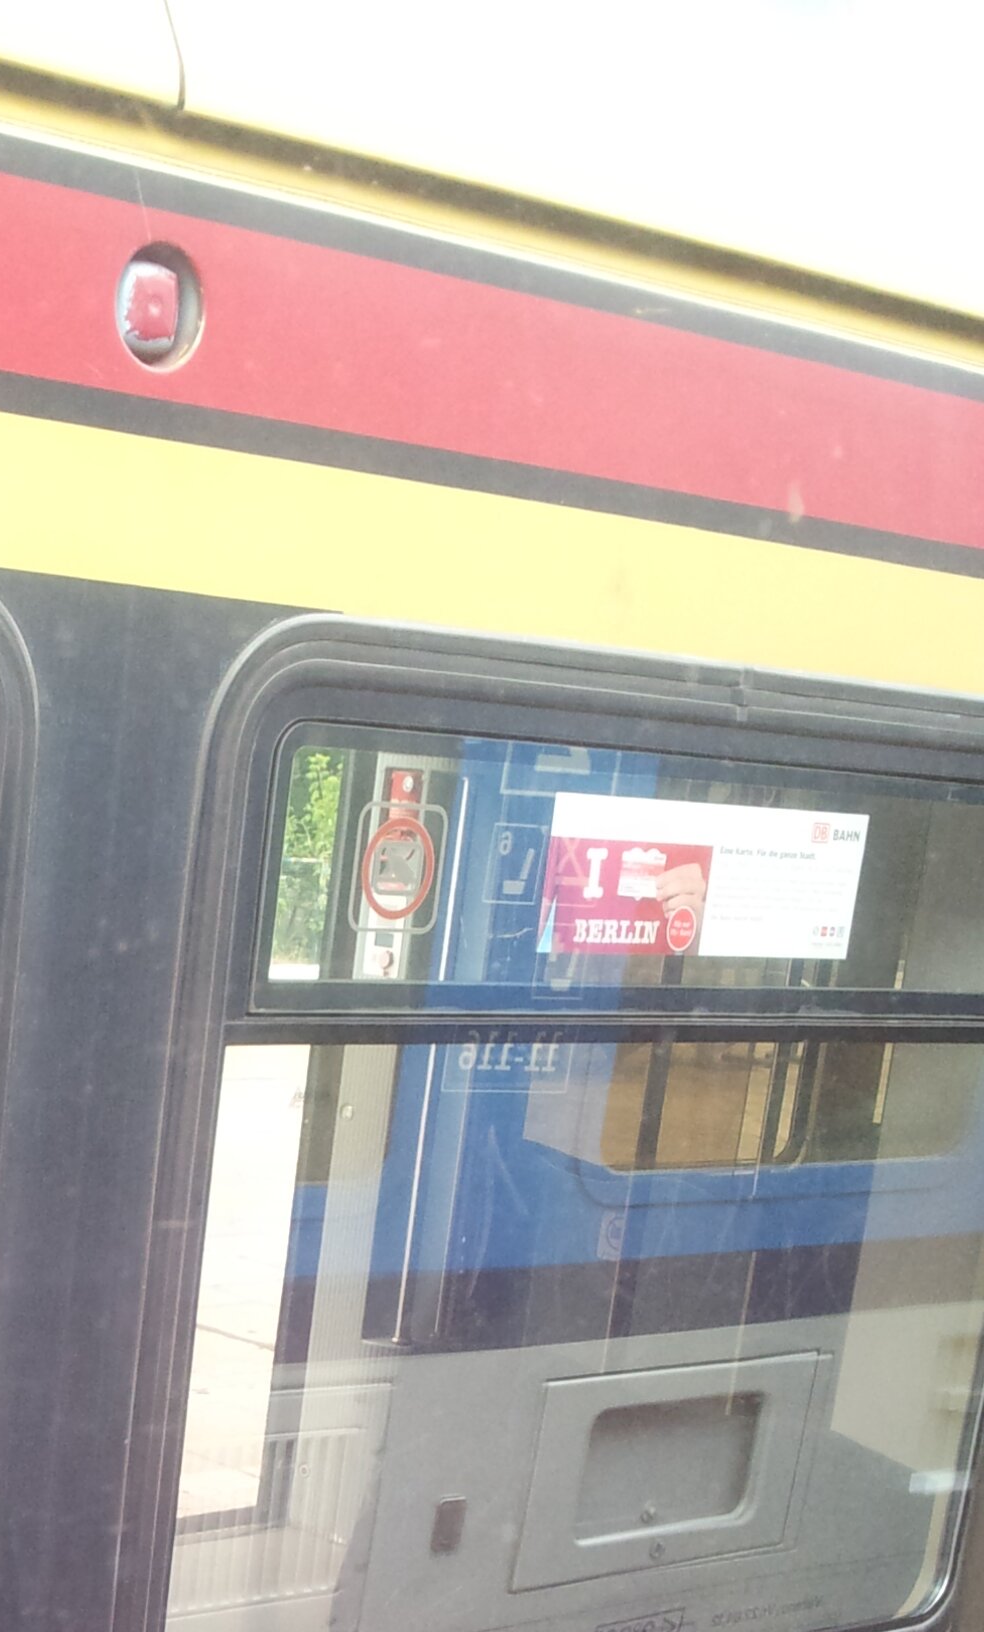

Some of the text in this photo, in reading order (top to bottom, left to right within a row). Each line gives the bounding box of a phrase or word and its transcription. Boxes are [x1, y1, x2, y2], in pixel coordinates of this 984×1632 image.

[812, 823, 861, 843] DB BAHN
[583, 847, 609, 900] I
[573, 918, 661, 945] BERLIN
